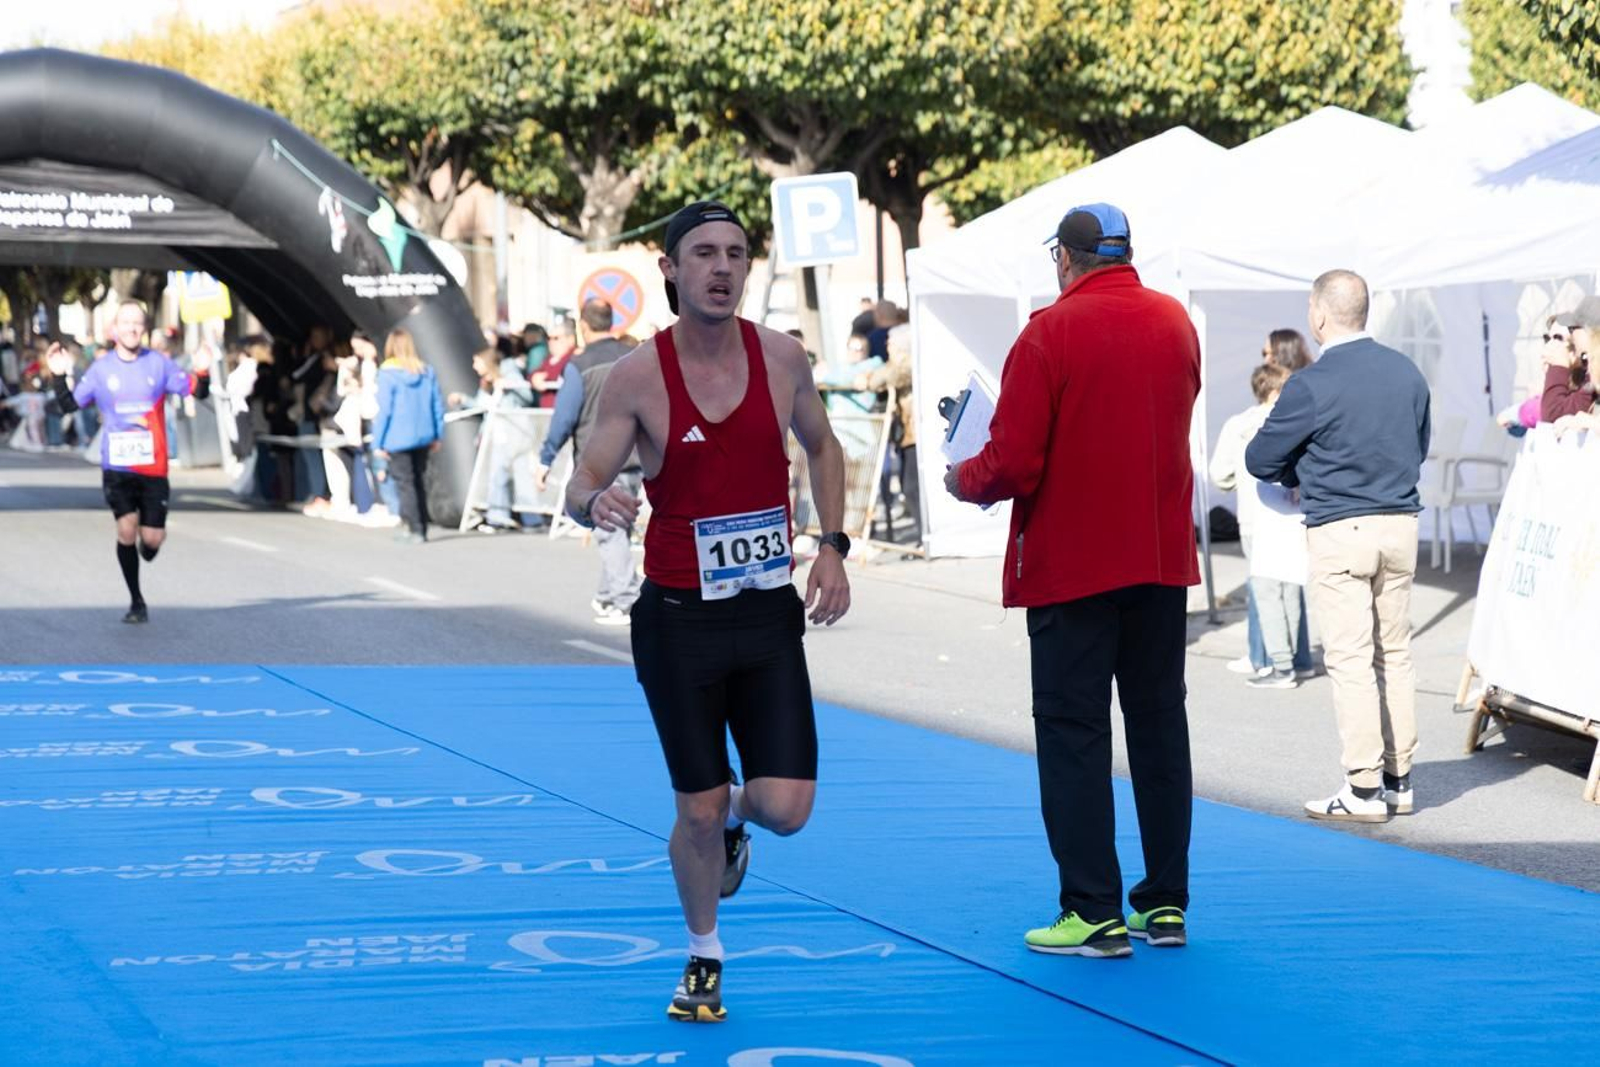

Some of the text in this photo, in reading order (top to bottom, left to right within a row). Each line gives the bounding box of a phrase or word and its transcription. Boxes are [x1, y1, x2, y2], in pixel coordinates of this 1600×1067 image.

[0, 191, 68, 211] atronato
[0, 209, 64, 229] eportes
[789, 186, 842, 257] P
[709, 531, 785, 568] 1033
[229, 954, 466, 972] MEDIA
